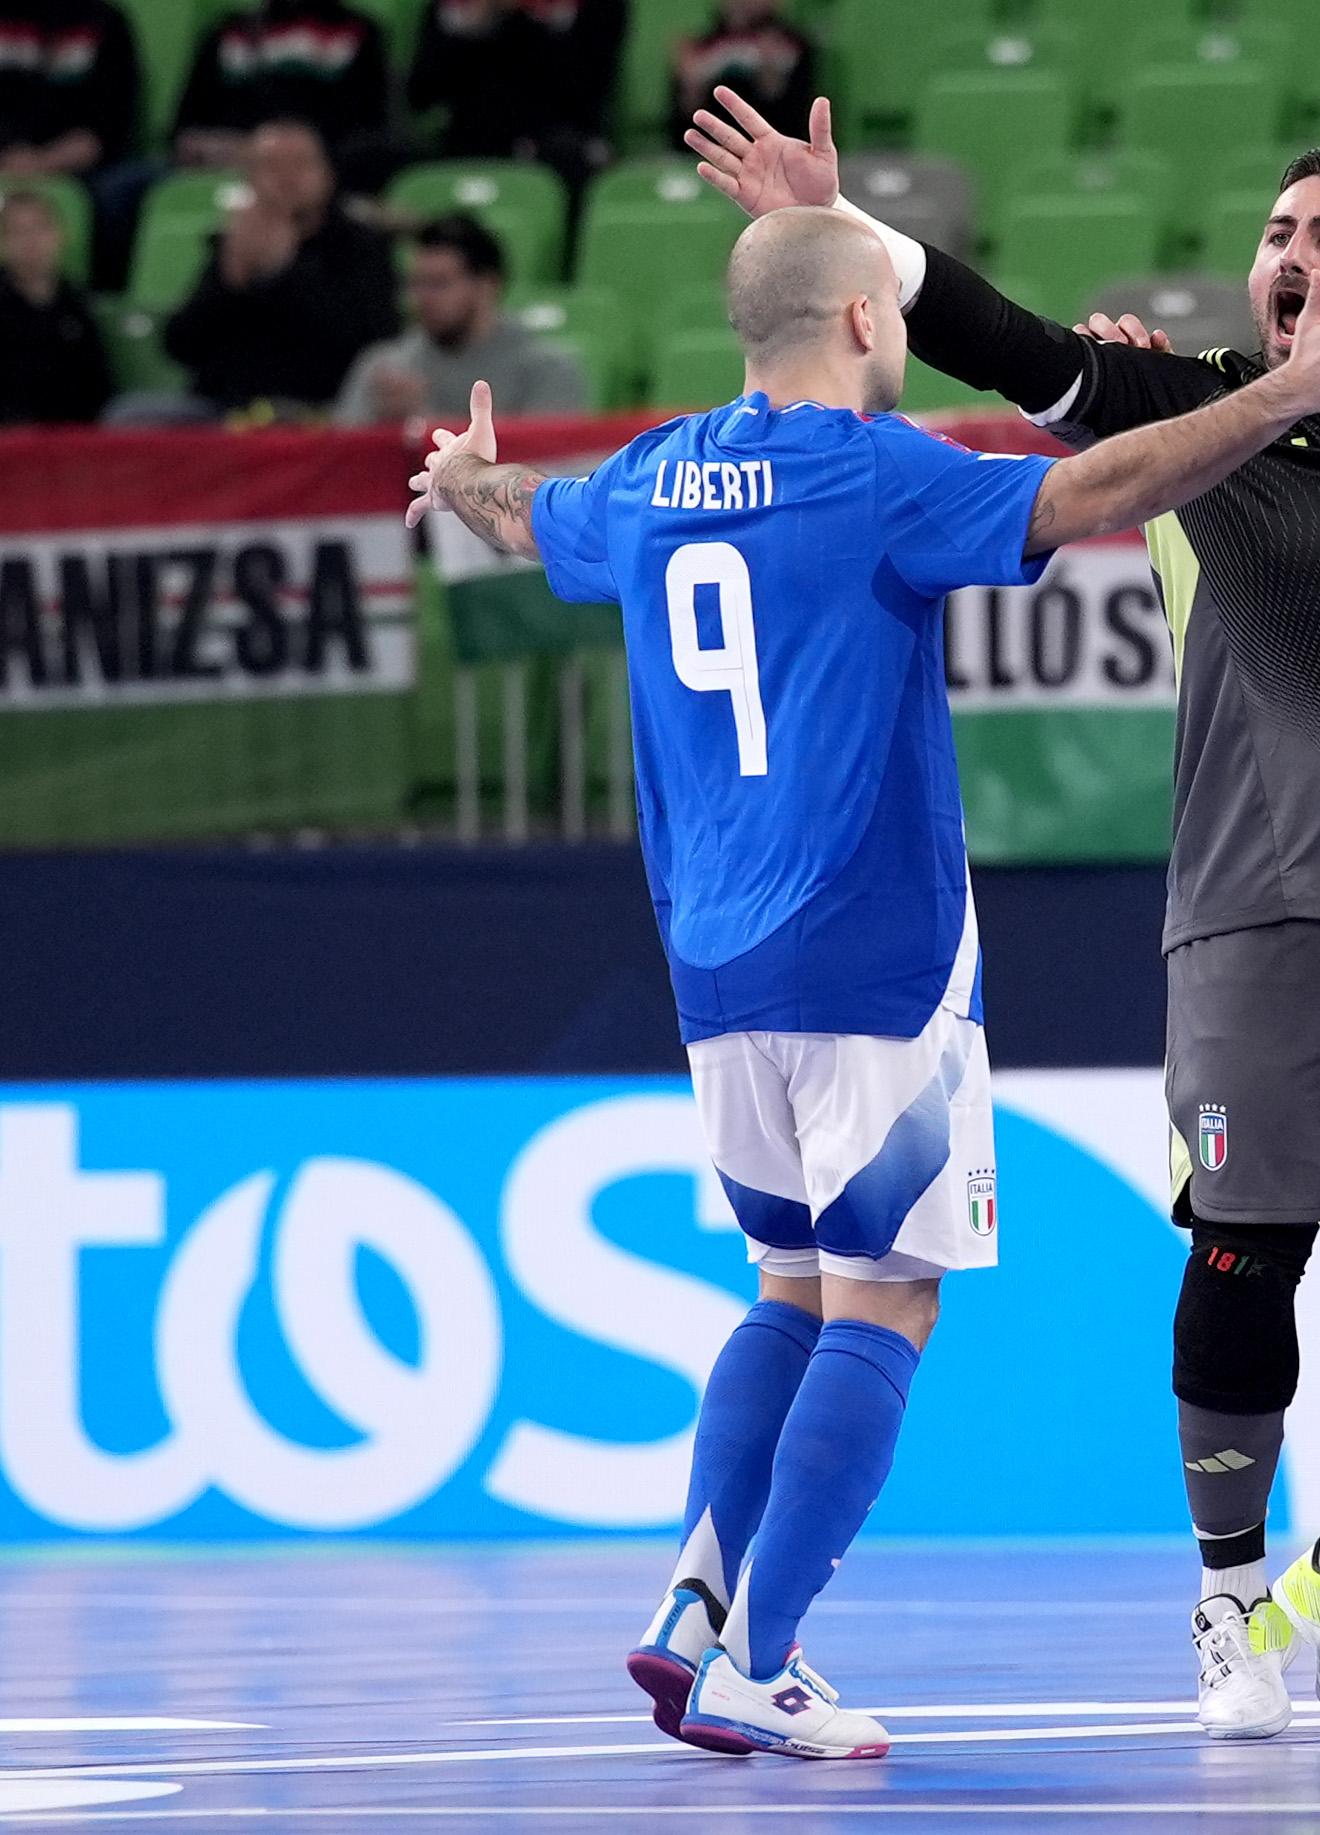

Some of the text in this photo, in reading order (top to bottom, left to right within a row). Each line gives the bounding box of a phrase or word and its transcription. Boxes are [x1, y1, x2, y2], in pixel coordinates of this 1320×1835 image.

[650, 459, 774, 510] LIBERTI
[665, 541, 768, 776] 9
[1201, 1117, 1224, 1130] ITALIA
[969, 1182, 993, 1195] ITALIA
